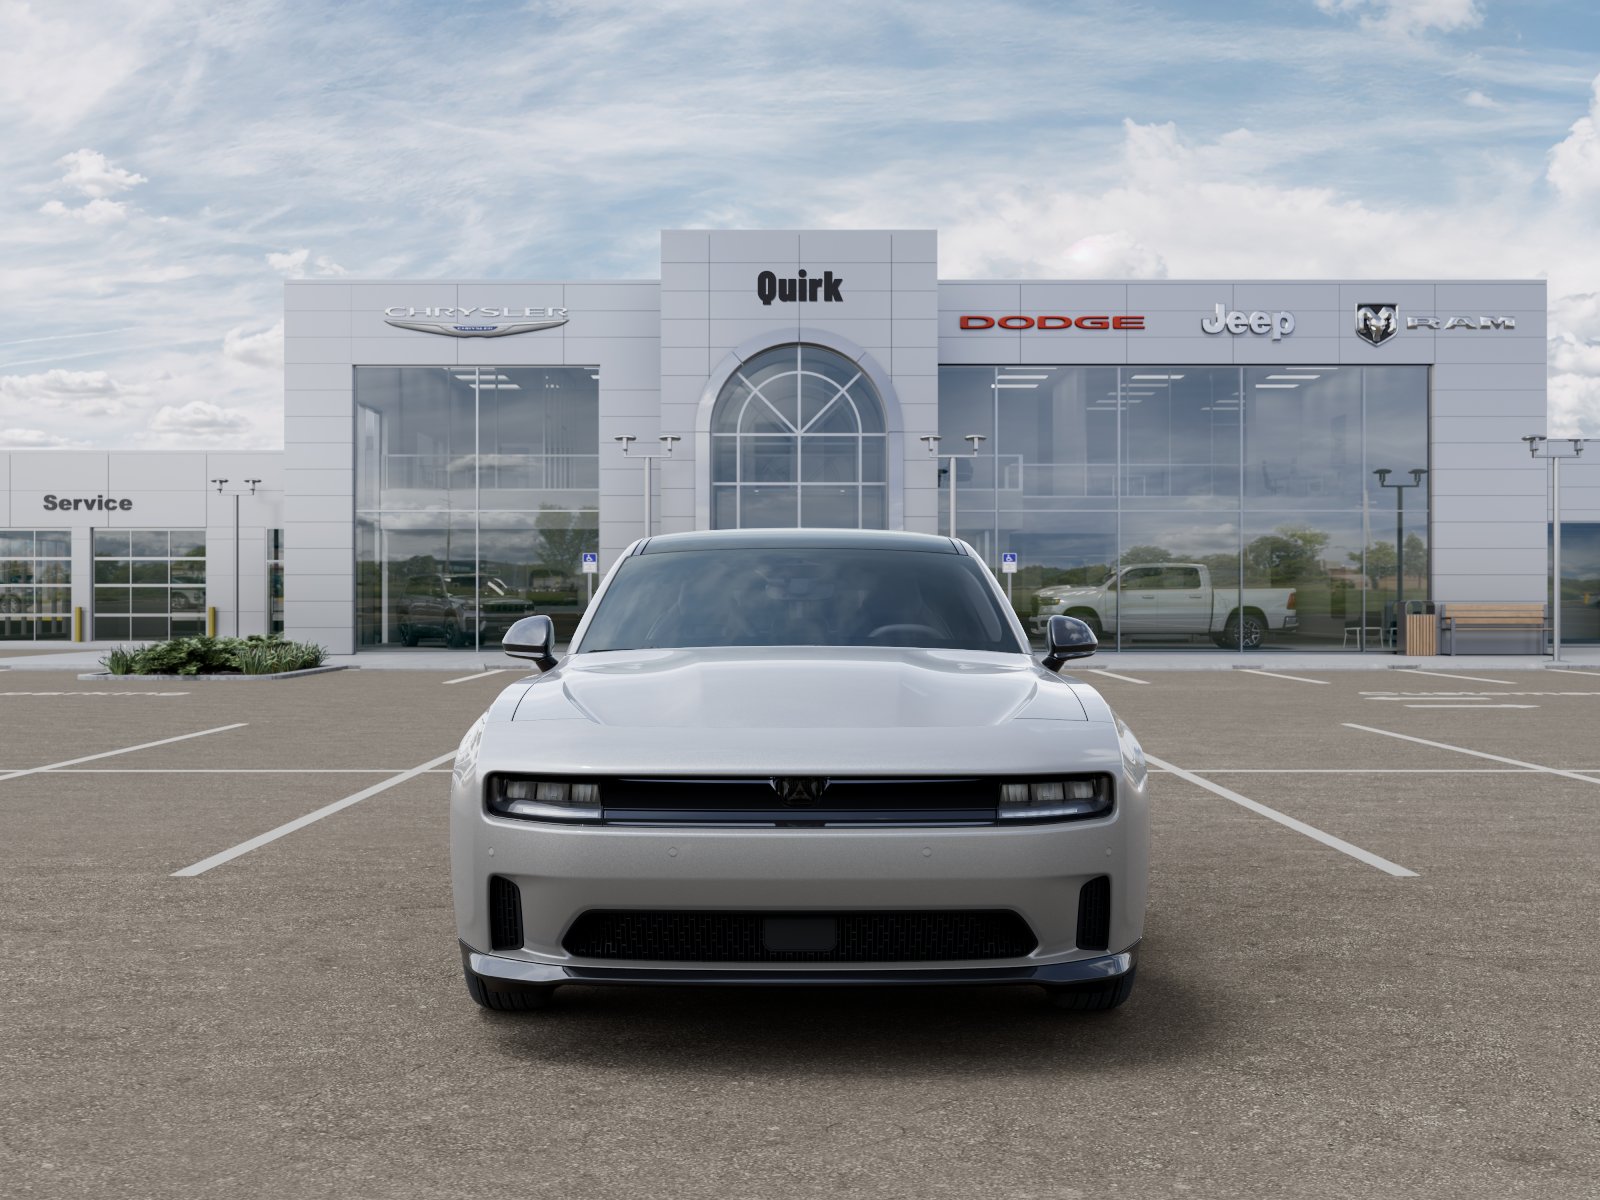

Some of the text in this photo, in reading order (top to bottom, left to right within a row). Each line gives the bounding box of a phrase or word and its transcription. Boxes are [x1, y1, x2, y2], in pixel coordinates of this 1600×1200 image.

[757, 269, 843, 305] Quirk
[384, 306, 569, 317] CHRYSLER
[959, 315, 1145, 330] DODGE
[1201, 303, 1295, 341] Jeep
[1406, 315, 1516, 329] RAM
[43, 494, 133, 511] Service
